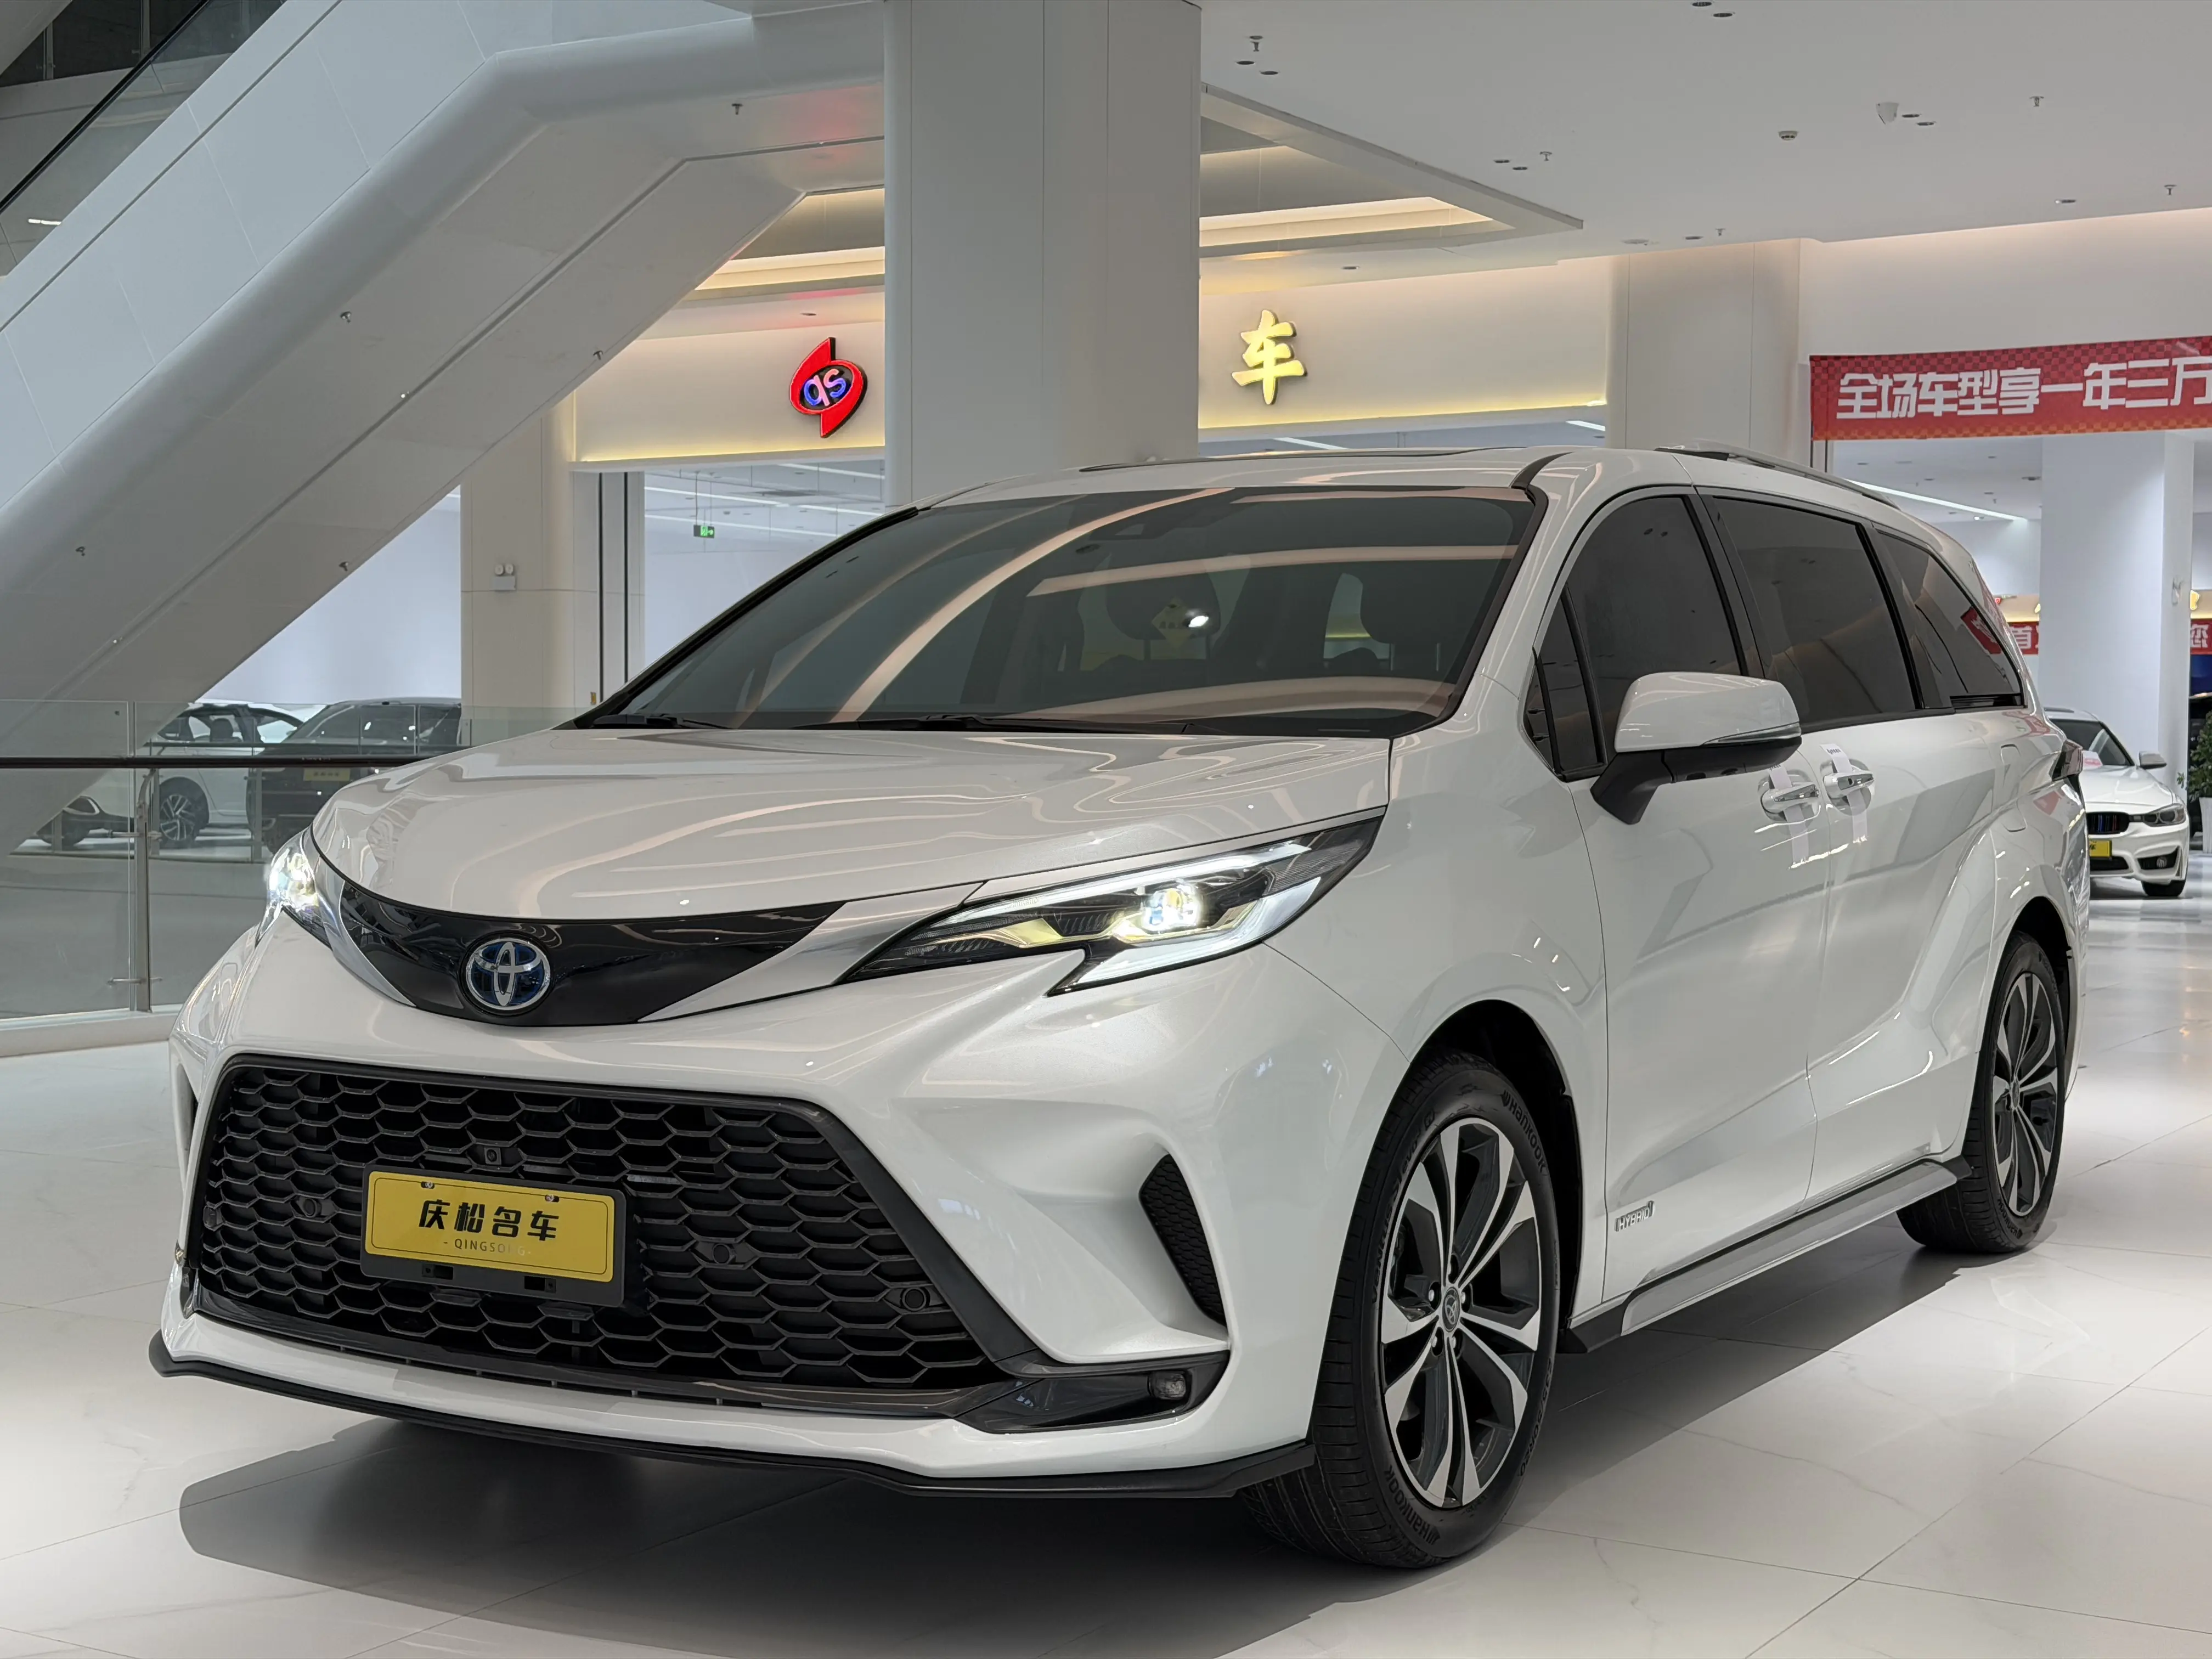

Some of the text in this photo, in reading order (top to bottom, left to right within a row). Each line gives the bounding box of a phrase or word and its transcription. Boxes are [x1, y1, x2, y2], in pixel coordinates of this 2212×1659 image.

[1232, 309, 1306, 405] 车
[1836, 356, 2212, 420] 全场车型享一年三万
[418, 1199, 560, 1242] 庆松名车
[1619, 1207, 1650, 1232] HYBRID
